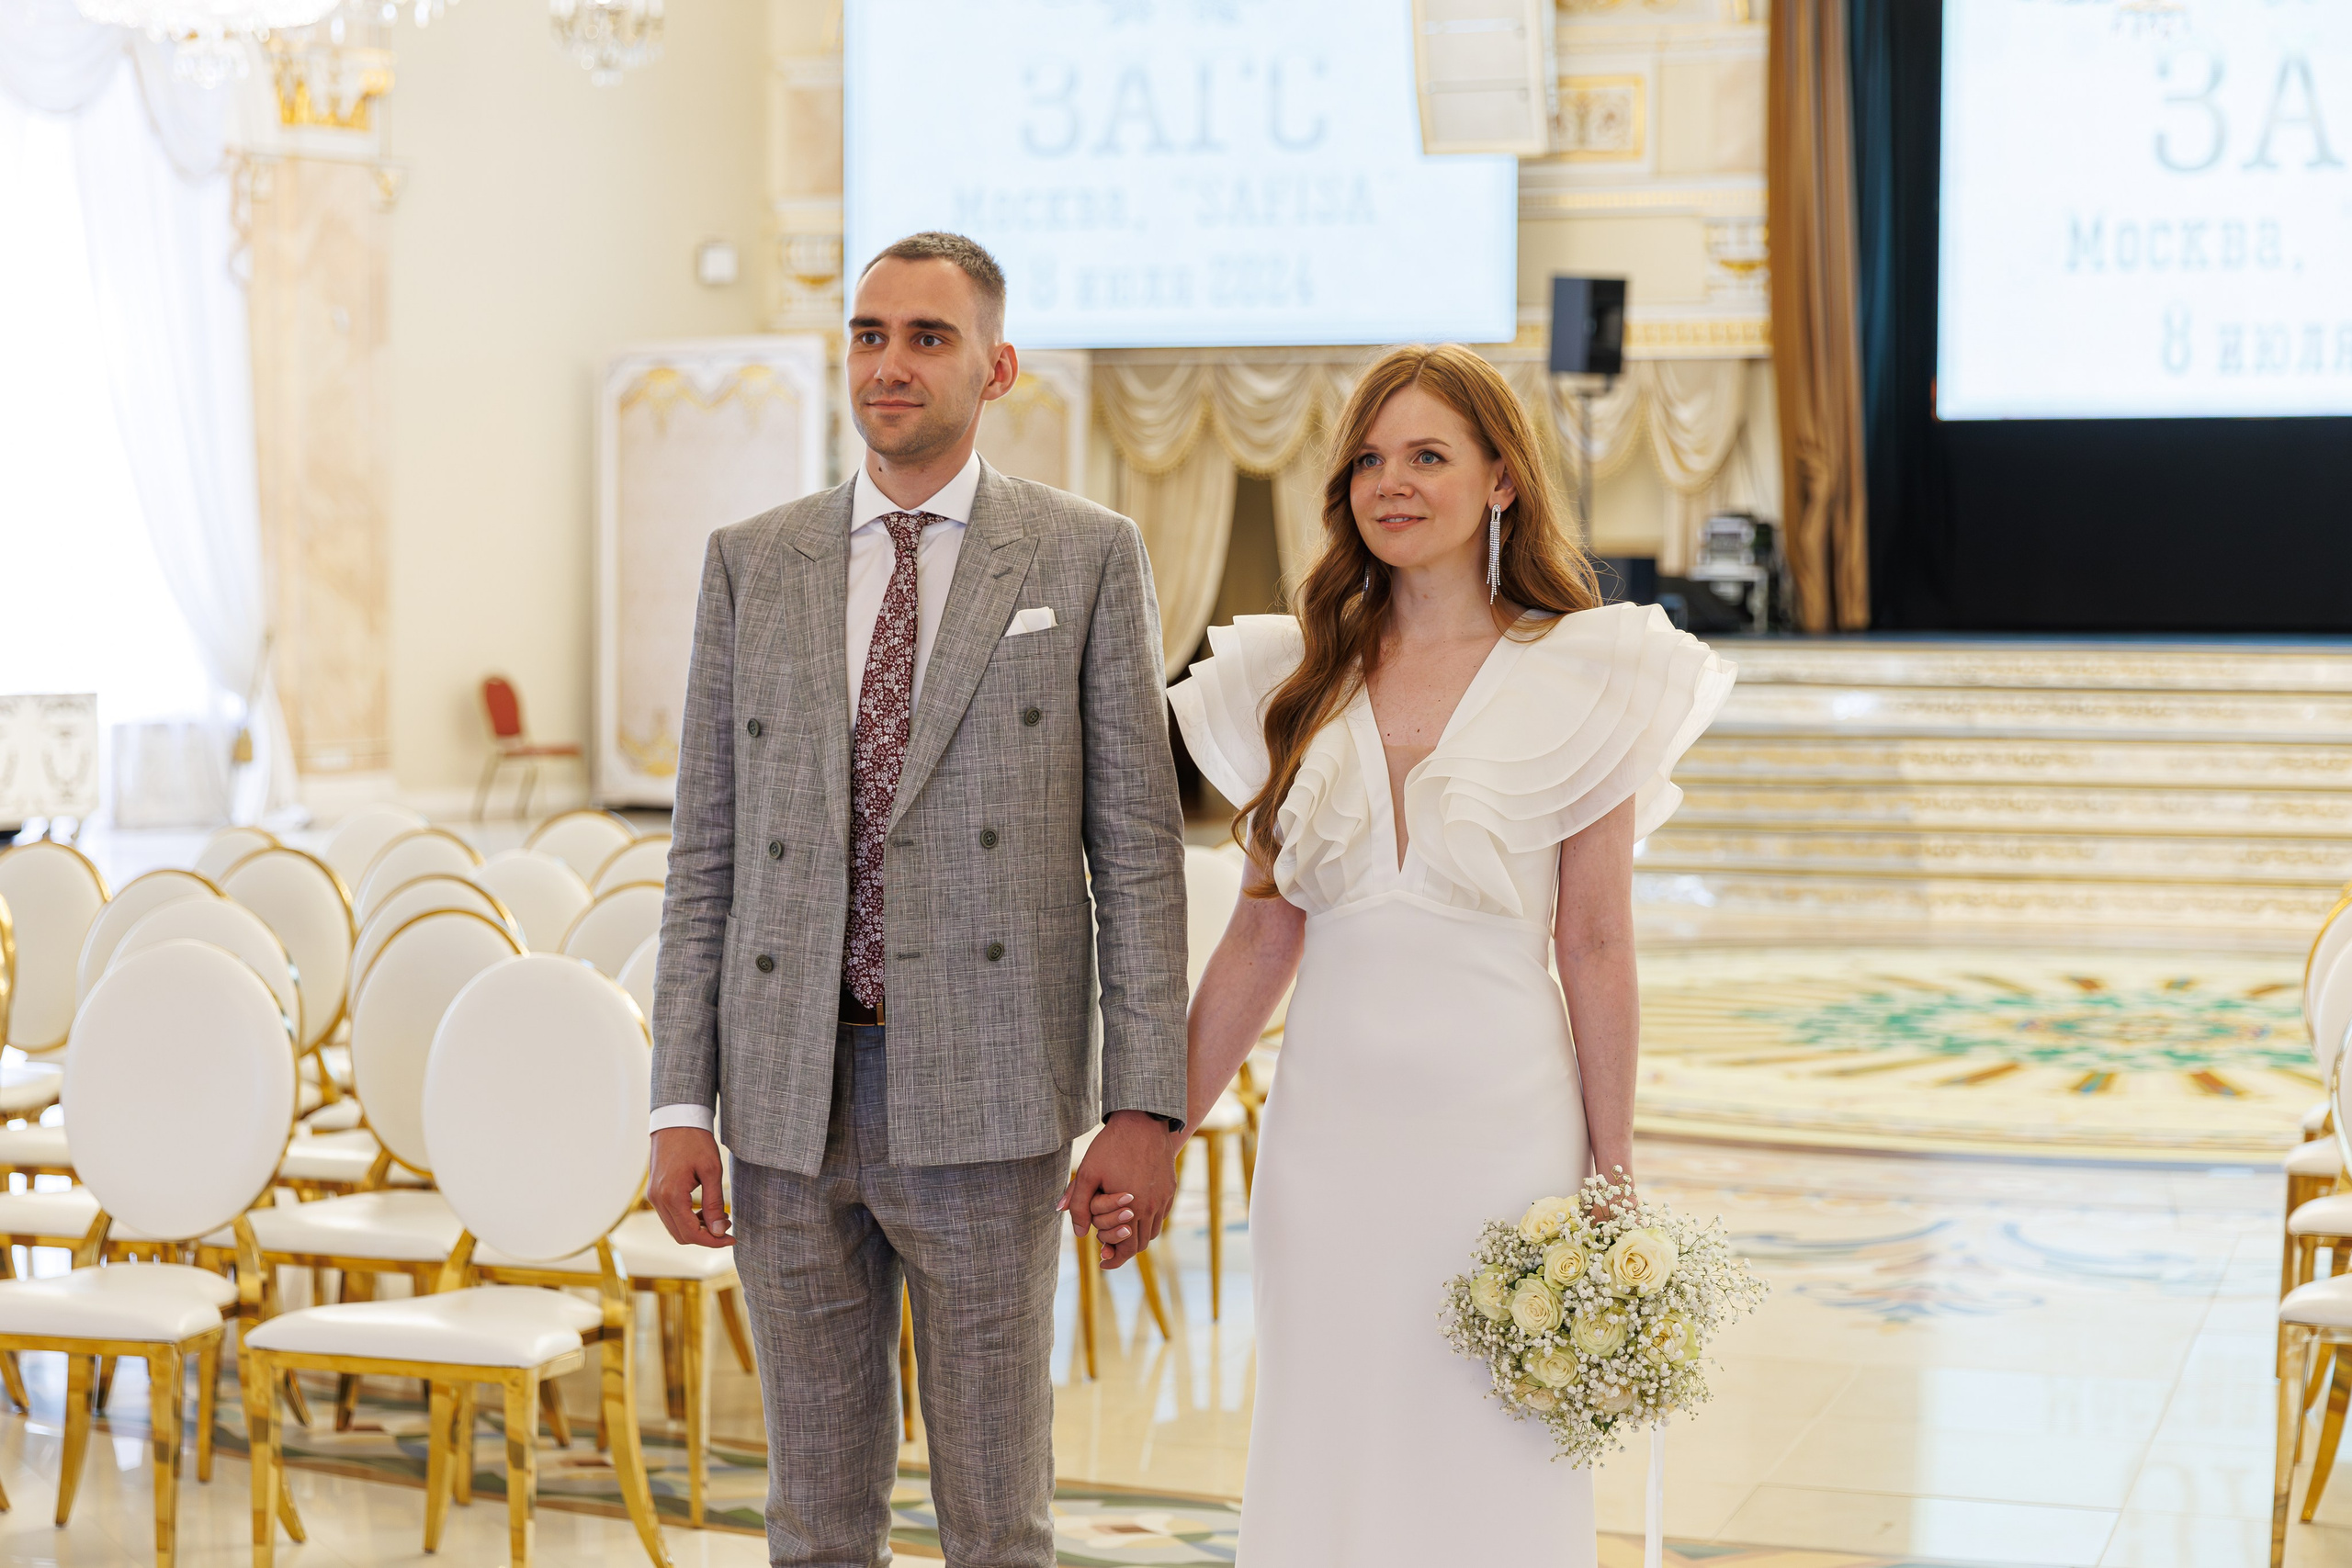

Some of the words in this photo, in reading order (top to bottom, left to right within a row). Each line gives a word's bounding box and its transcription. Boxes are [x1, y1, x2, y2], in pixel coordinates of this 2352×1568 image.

[1018, 48, 1329, 158] ЗАГС
[2152, 41, 2347, 175] ЗА
[2064, 208, 2305, 279] Москва,
[2160, 299, 2193, 378] 8
